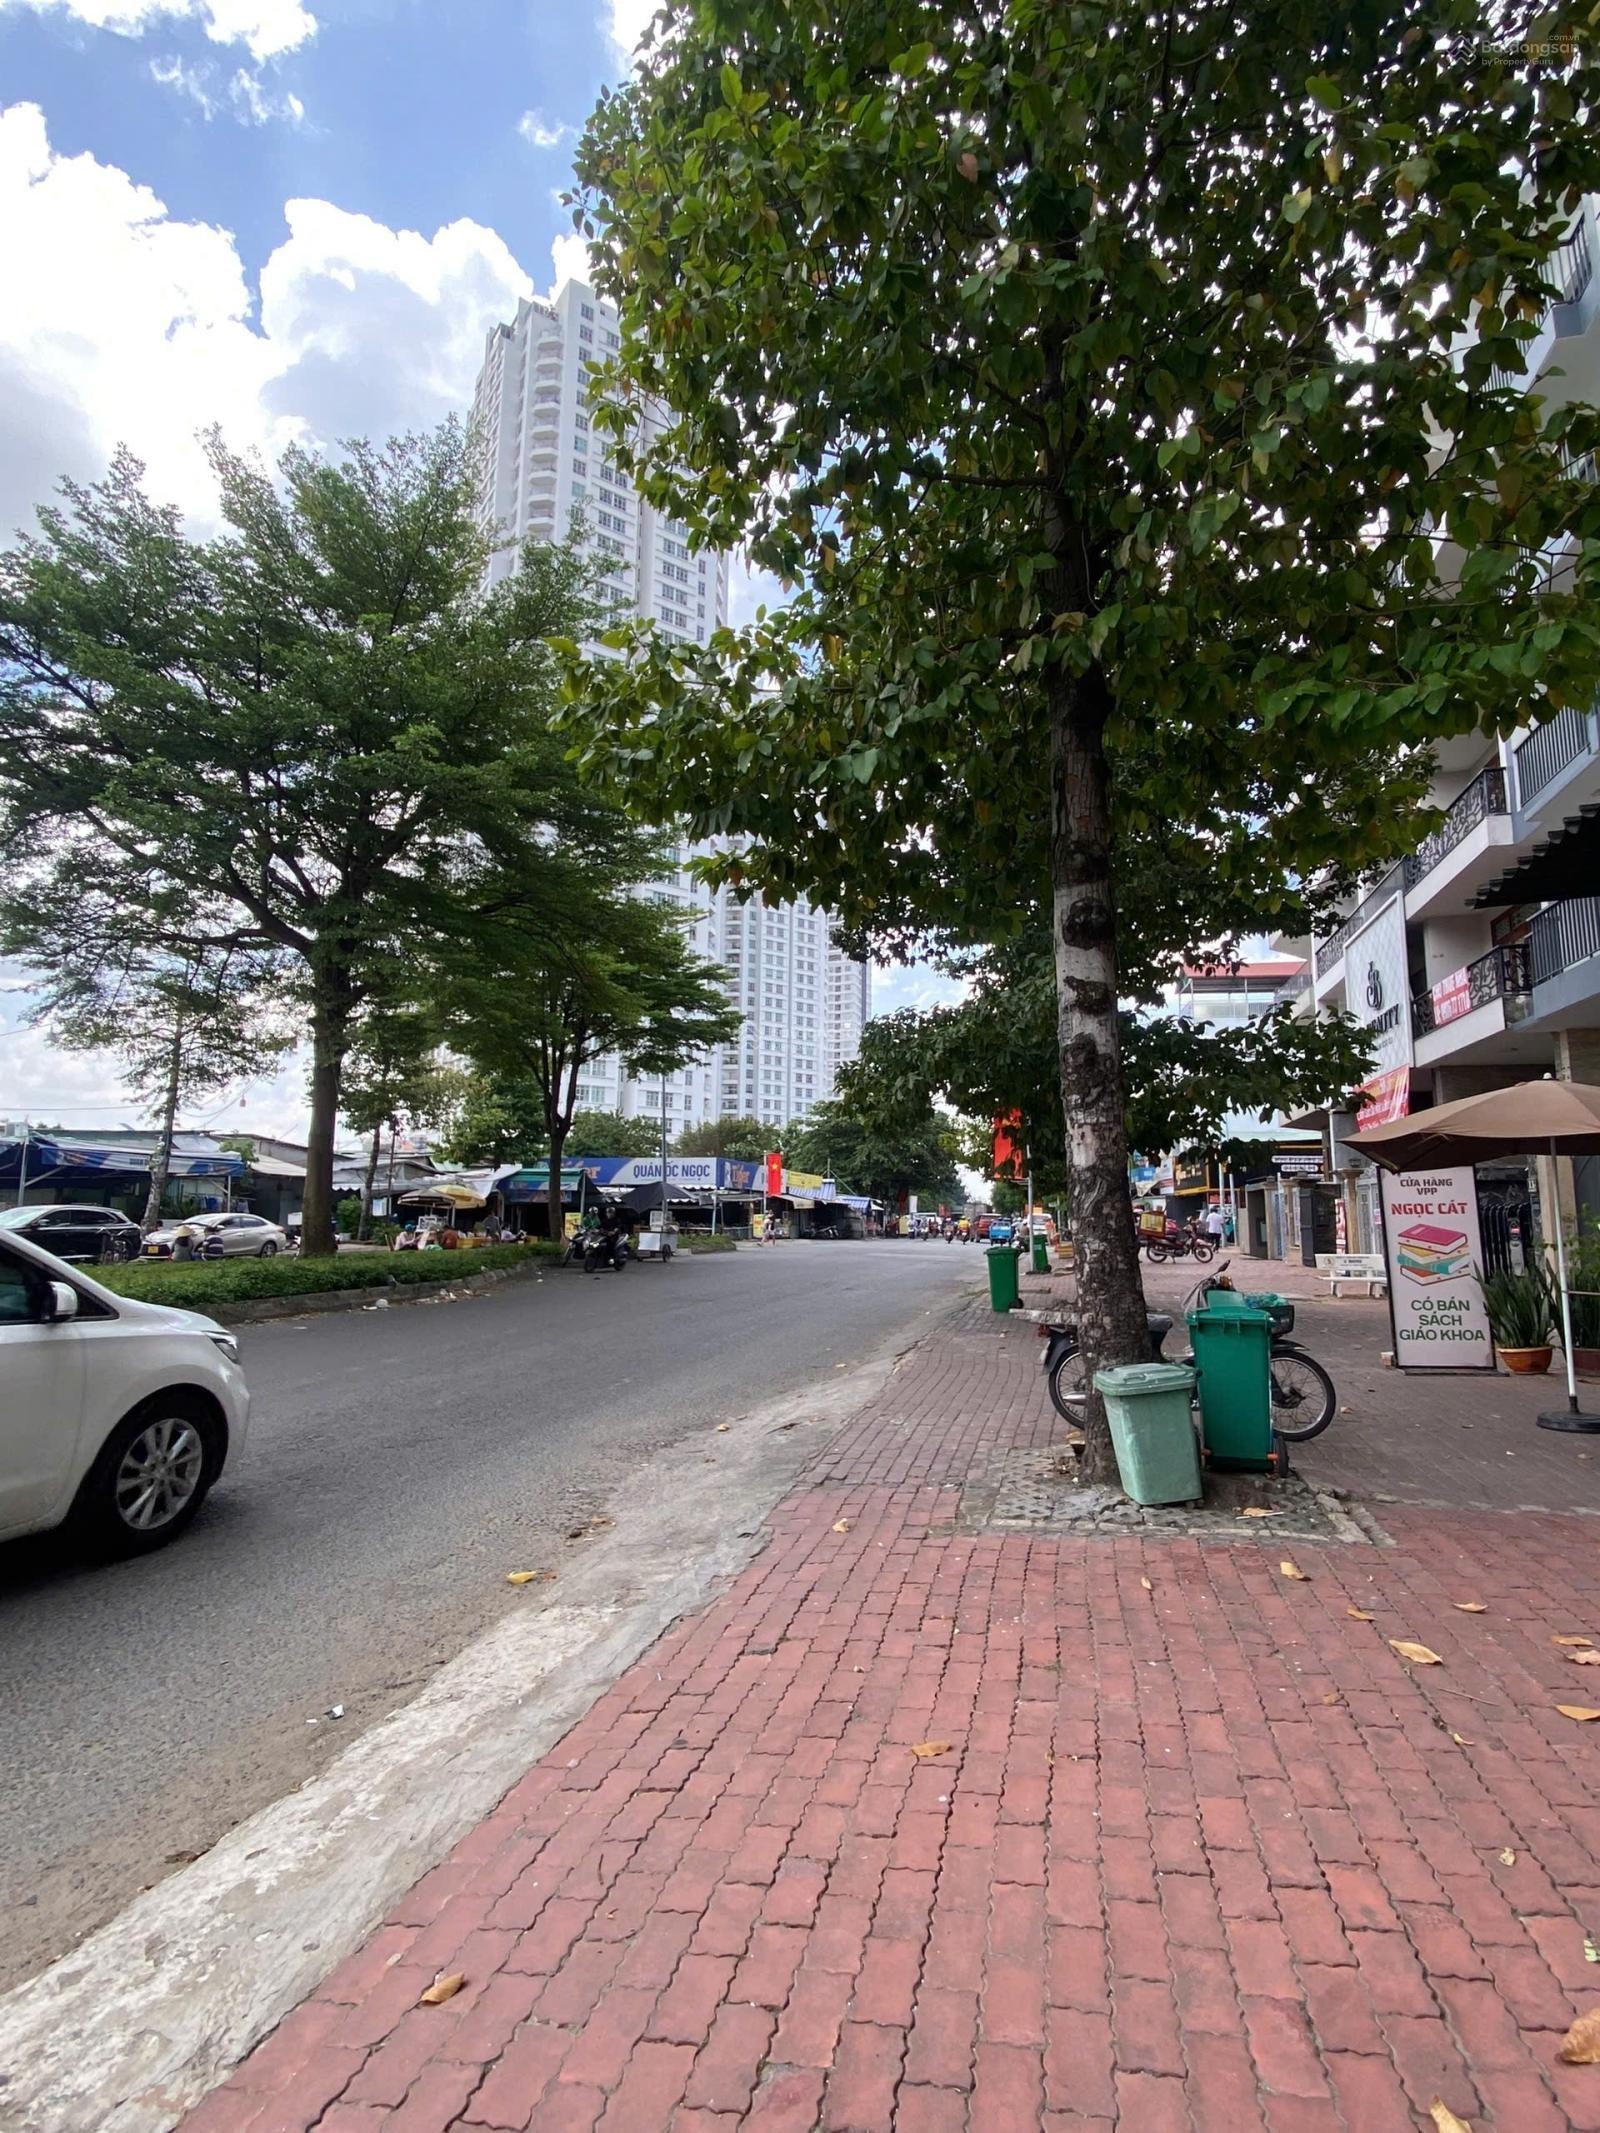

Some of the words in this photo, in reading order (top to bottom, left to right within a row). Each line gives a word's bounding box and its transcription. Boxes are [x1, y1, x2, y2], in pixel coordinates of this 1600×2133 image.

[681, 1164, 711, 1181] NGỌC
[1399, 1175, 1421, 1188] CỬA
[1423, 1177, 1453, 1187] HÀNG
[1416, 1187, 1438, 1196] VPP
[1391, 1202, 1434, 1218] NGỌC
[1437, 1200, 1468, 1215] CÁT
[1411, 1296, 1434, 1311] CÓ
[1437, 1296, 1470, 1311] BÁN
[1418, 1311, 1463, 1326] SÁCH
[1399, 1326, 1437, 1341] GIÁO
[1439, 1329, 1486, 1341] KHOA
